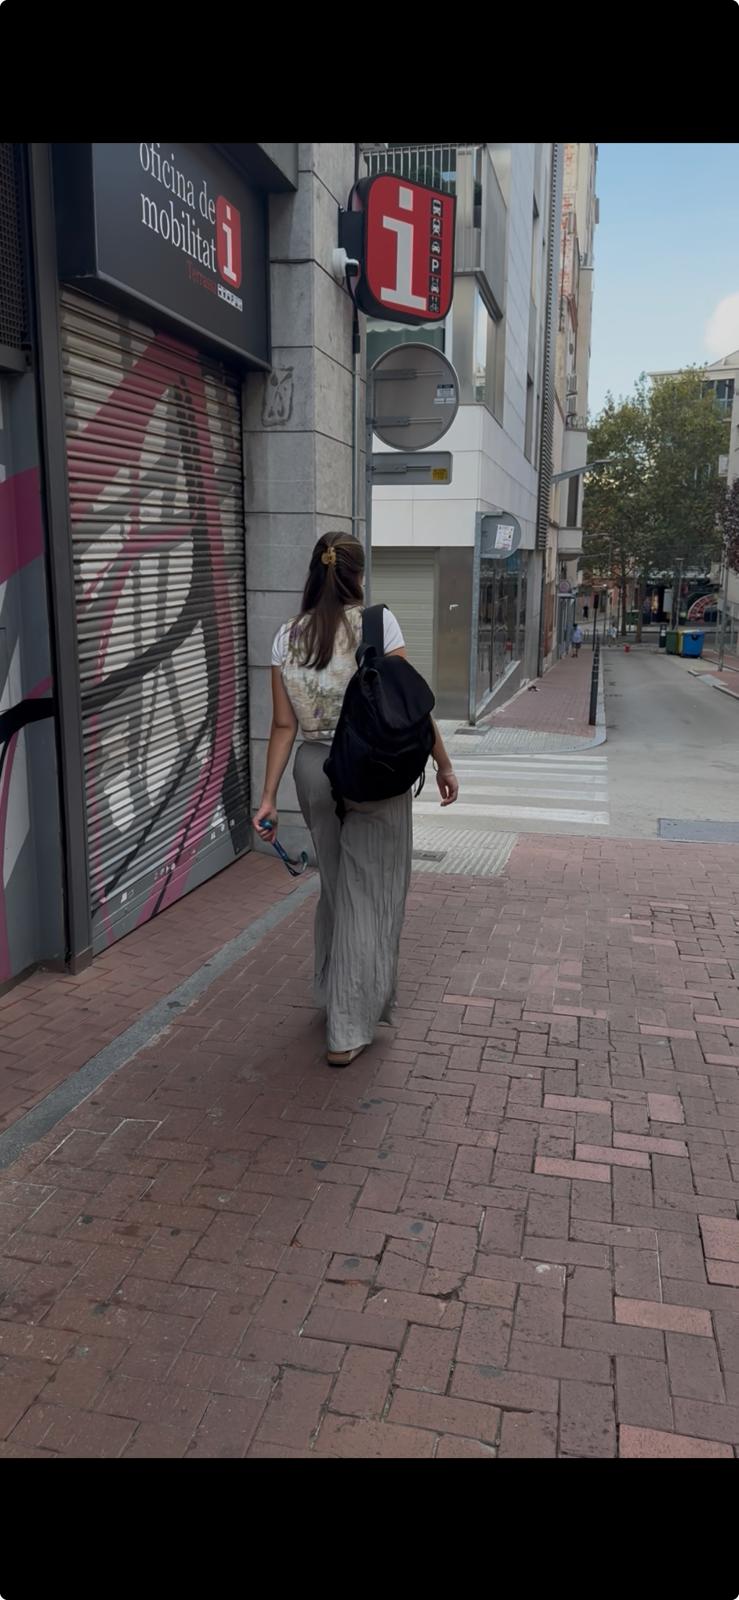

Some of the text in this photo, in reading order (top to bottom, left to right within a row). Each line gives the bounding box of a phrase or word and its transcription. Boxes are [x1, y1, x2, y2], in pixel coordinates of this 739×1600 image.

[139, 143, 216, 224] oficina de
[140, 193, 217, 272] mobilitat
[222, 205, 237, 282] i
[380, 186, 427, 311] i
[431, 259, 440, 273] P
